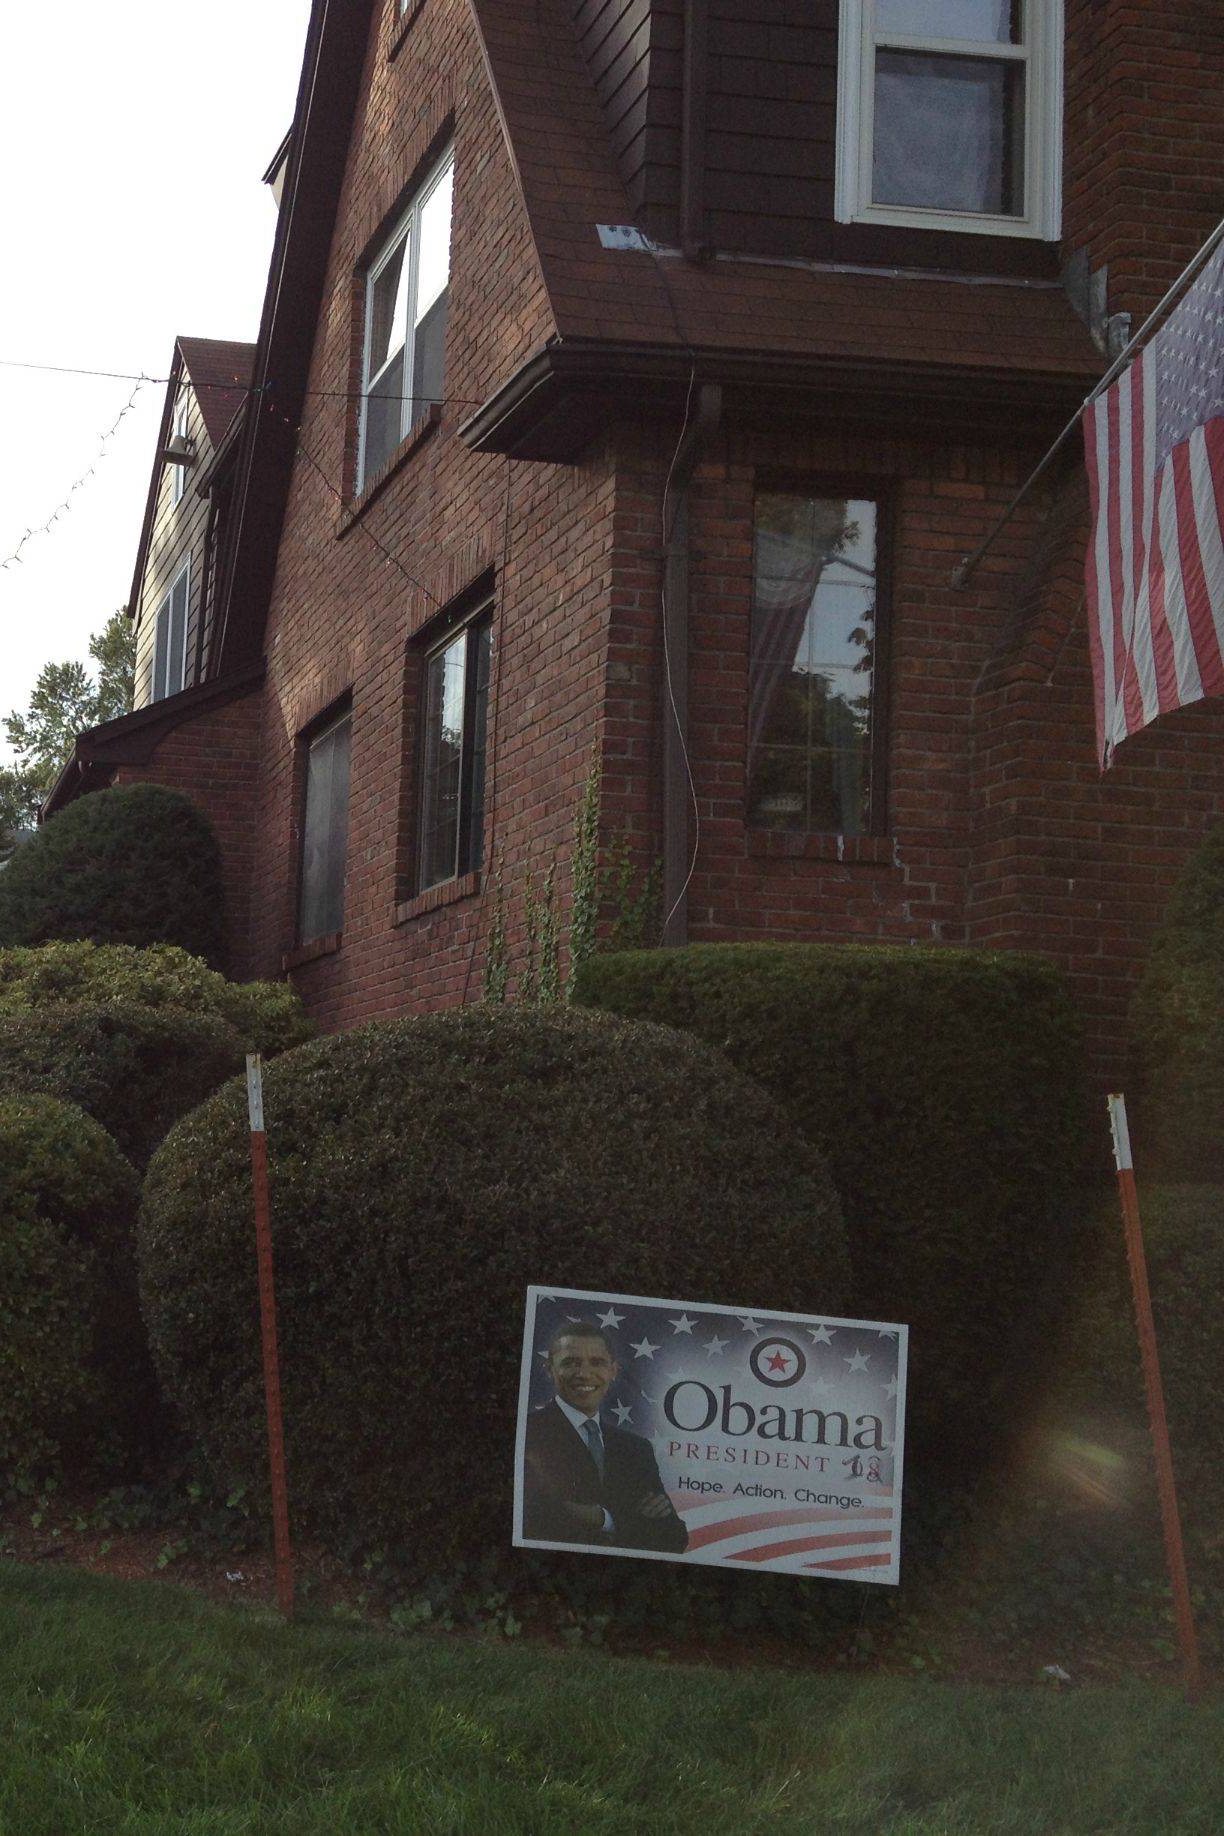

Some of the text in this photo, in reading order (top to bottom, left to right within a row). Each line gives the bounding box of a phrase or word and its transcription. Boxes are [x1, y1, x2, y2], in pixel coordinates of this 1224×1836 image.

[663, 1380, 888, 1451] Obama
[669, 1441, 829, 1472] PRESIDENT
[678, 1476, 865, 1509] Hope. Action. Change.
